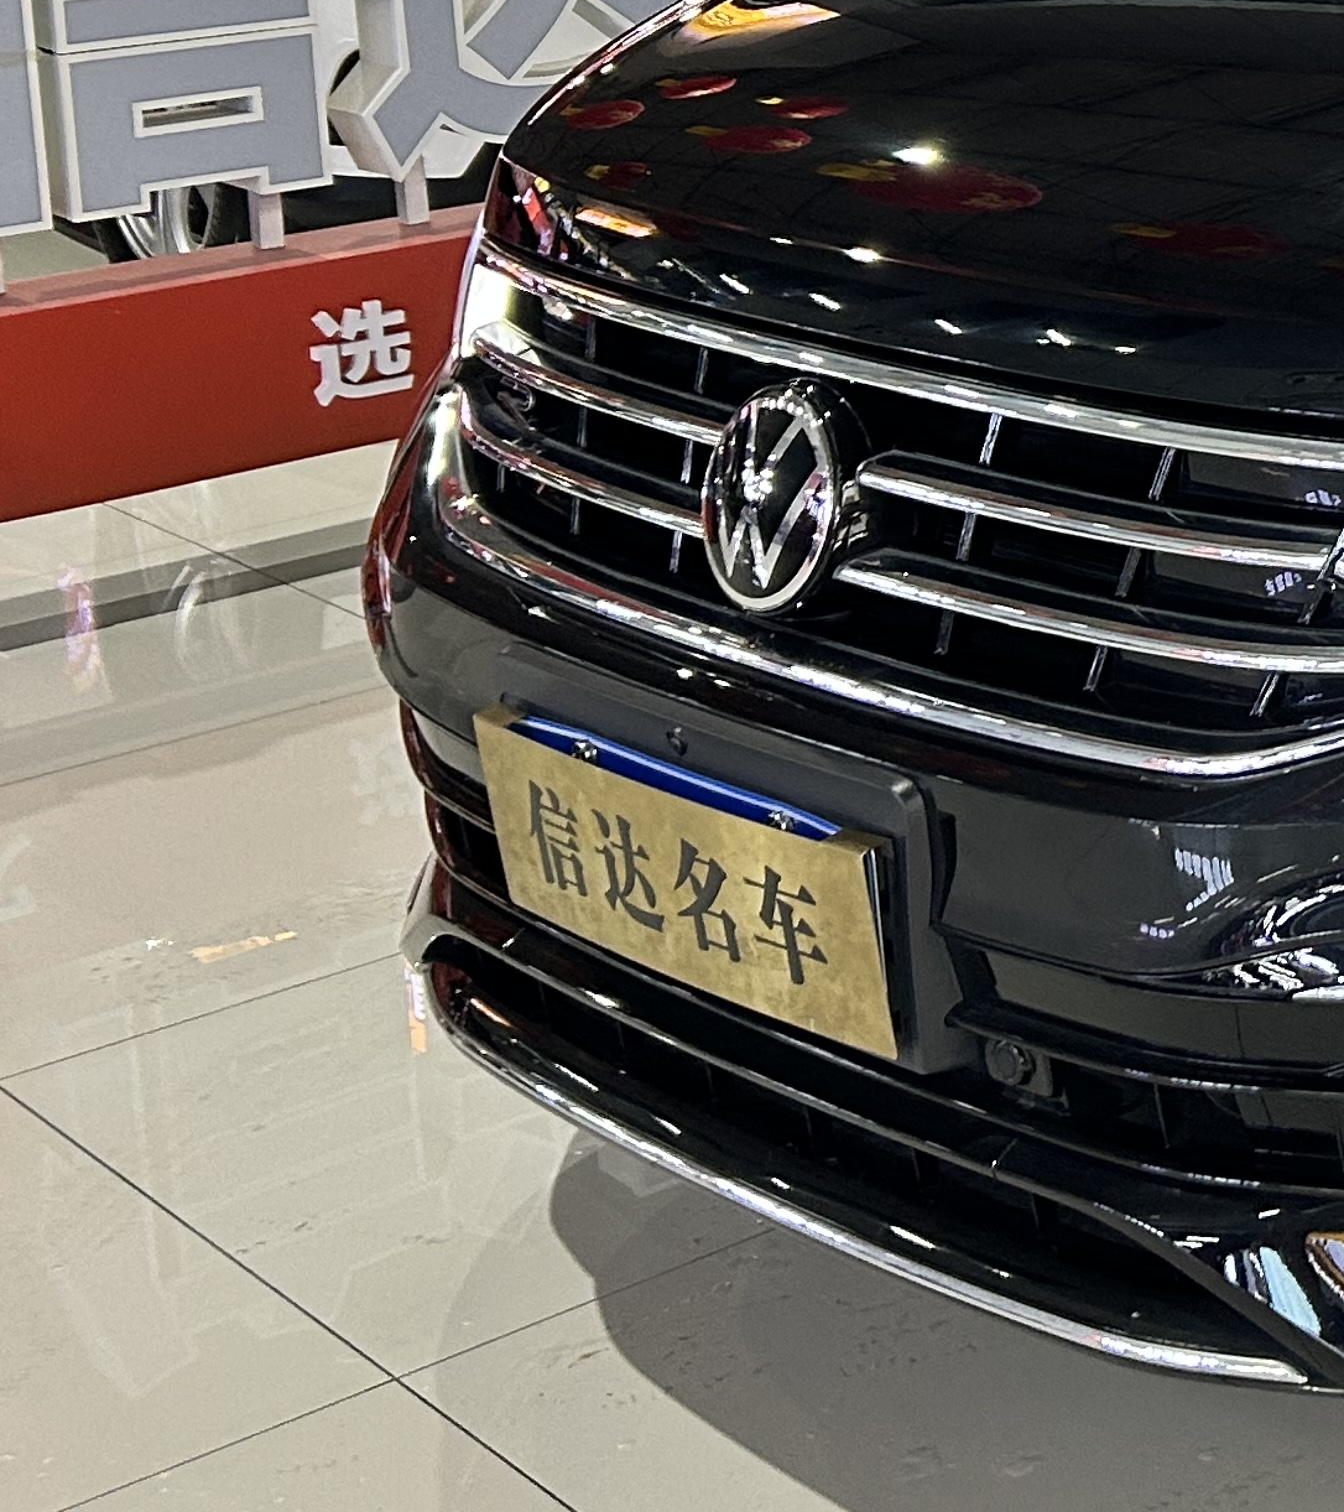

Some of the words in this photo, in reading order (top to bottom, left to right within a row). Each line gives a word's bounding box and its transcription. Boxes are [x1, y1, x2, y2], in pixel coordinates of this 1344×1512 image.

[310, 298, 416, 408] 选
[528, 779, 830, 986] 信达名车
